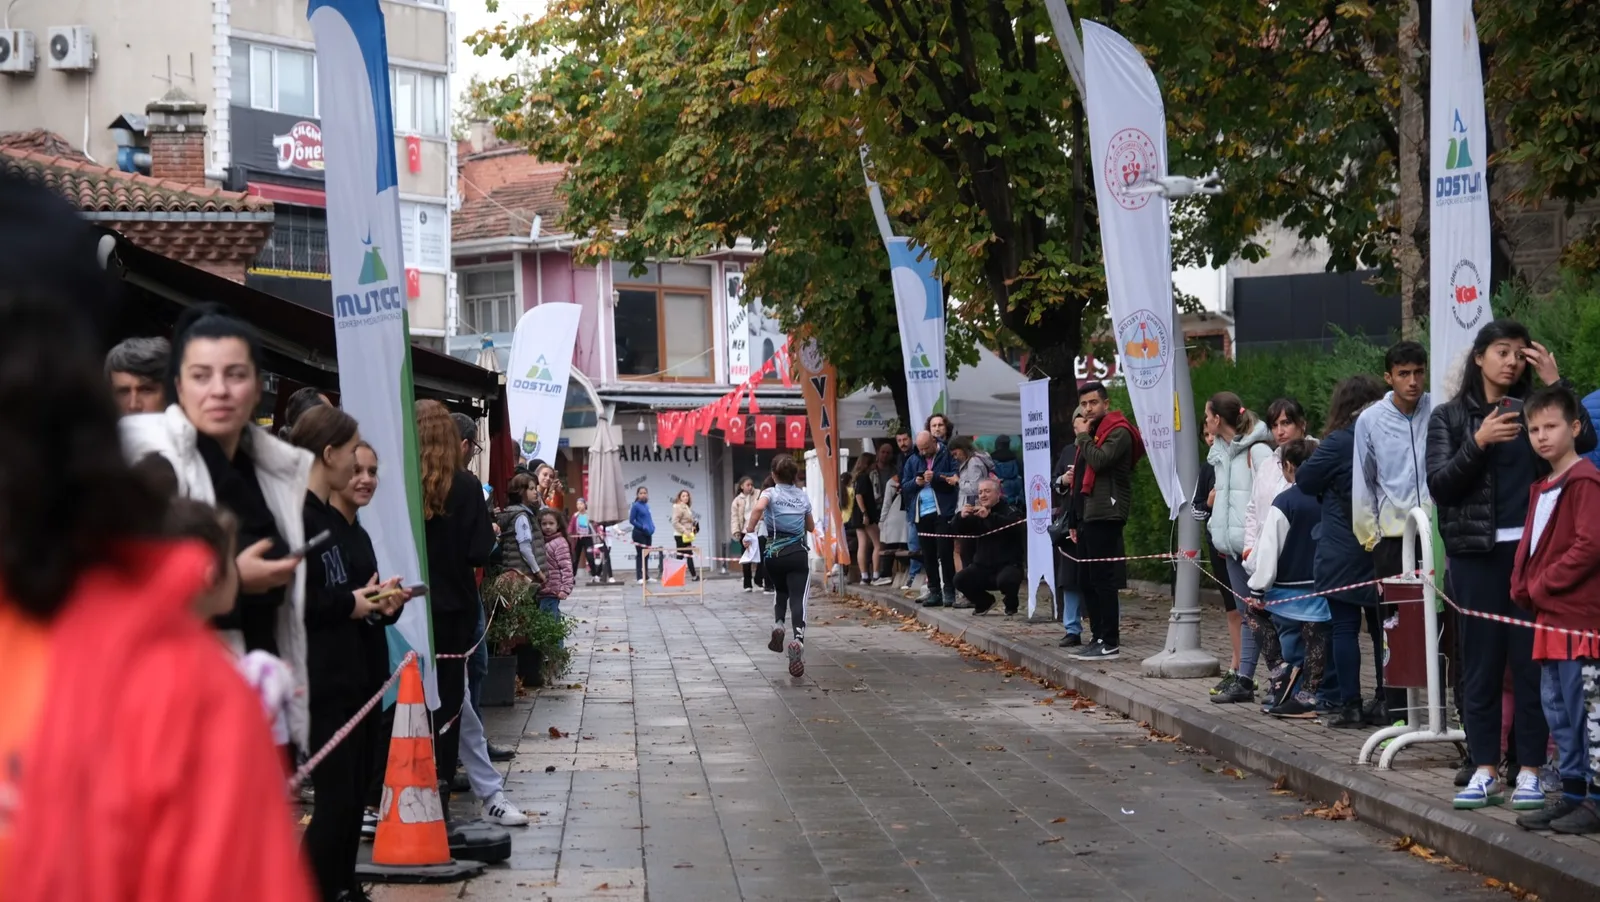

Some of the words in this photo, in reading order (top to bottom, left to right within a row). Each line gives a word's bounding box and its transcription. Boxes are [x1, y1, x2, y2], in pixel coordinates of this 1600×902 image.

[272, 133, 325, 170] Döne
[513, 380, 563, 394] DOSTUM
[619, 445, 699, 468] AHARATÇI
